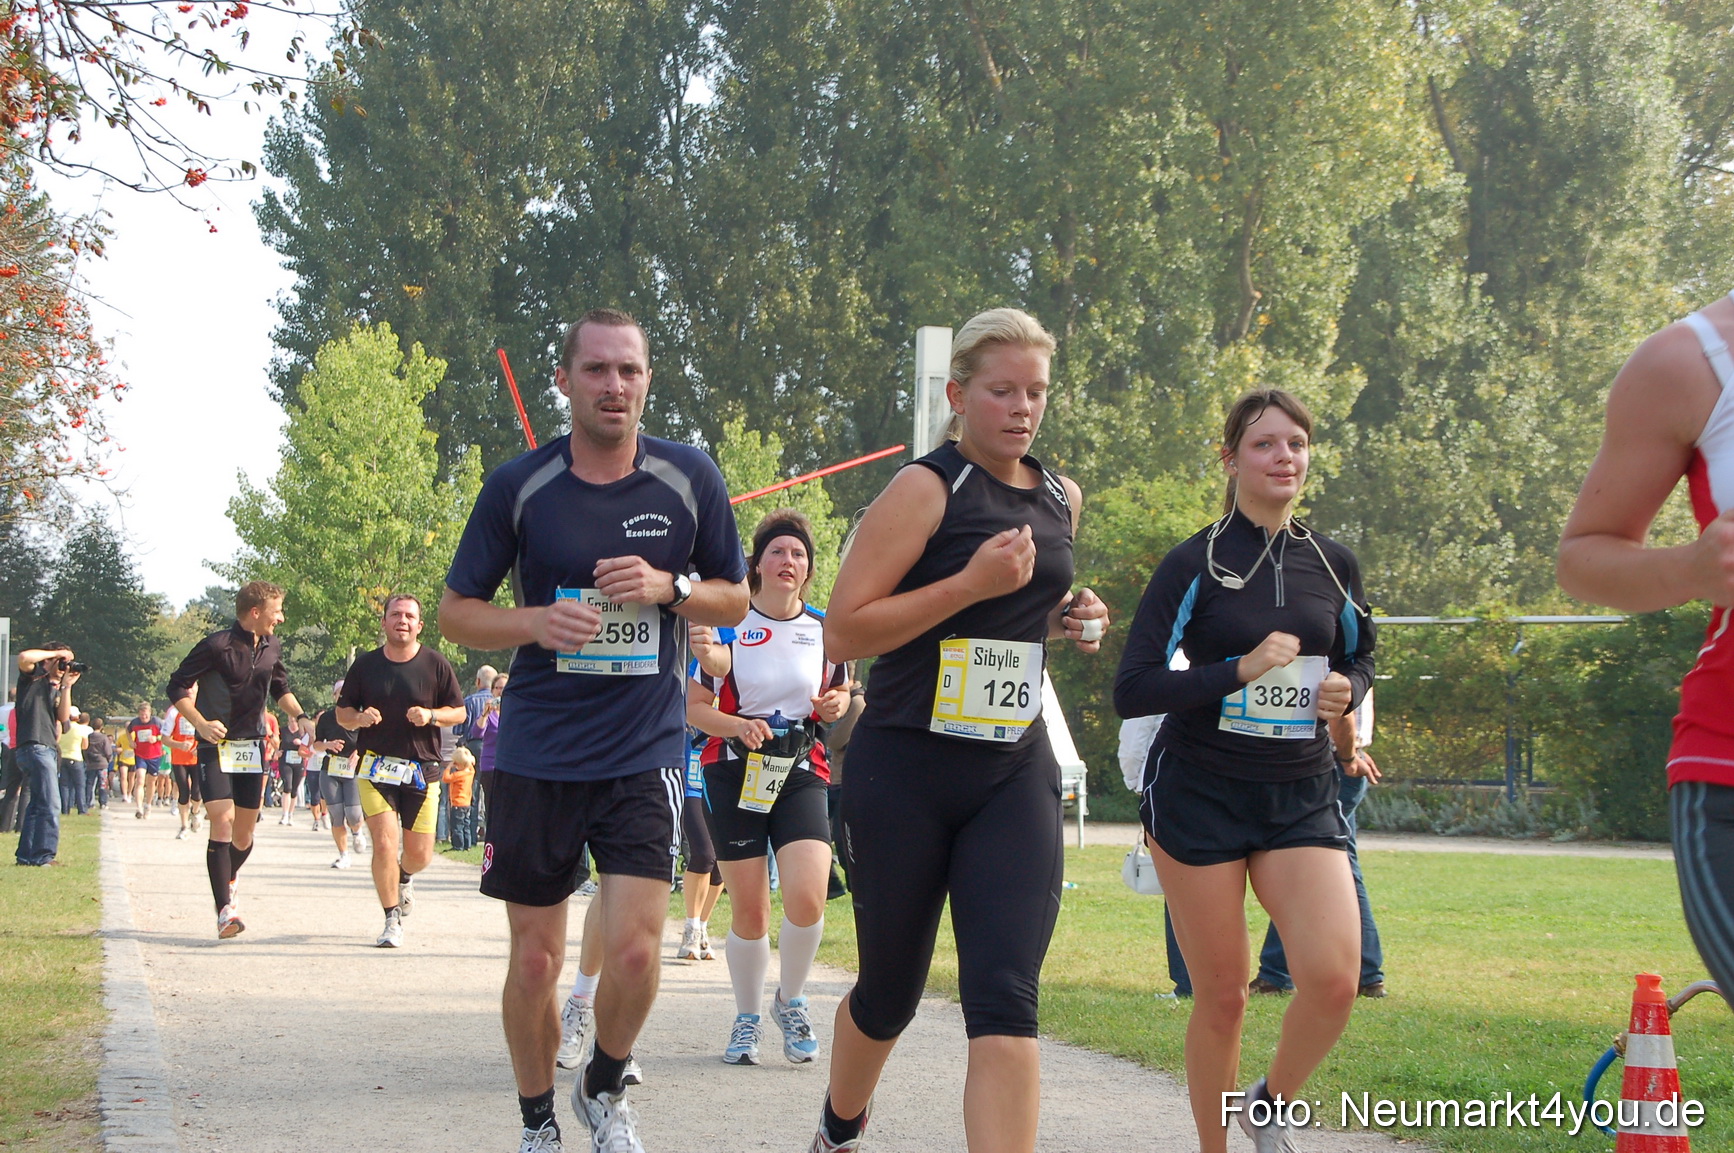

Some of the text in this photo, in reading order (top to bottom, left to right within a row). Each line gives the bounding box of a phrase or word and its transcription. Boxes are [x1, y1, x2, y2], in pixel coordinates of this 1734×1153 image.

[622, 512, 673, 529] Feuerwehr
[625, 528, 669, 538] Ezelsdorf
[588, 621, 650, 644] 2598
[742, 629, 764, 640] tkn
[974, 646, 1020, 672] Sibylle
[943, 674, 952, 688] D
[983, 679, 1031, 709] 126
[1254, 685, 1311, 709] 3828
[235, 751, 254, 762] 267
[379, 761, 399, 774] 244
